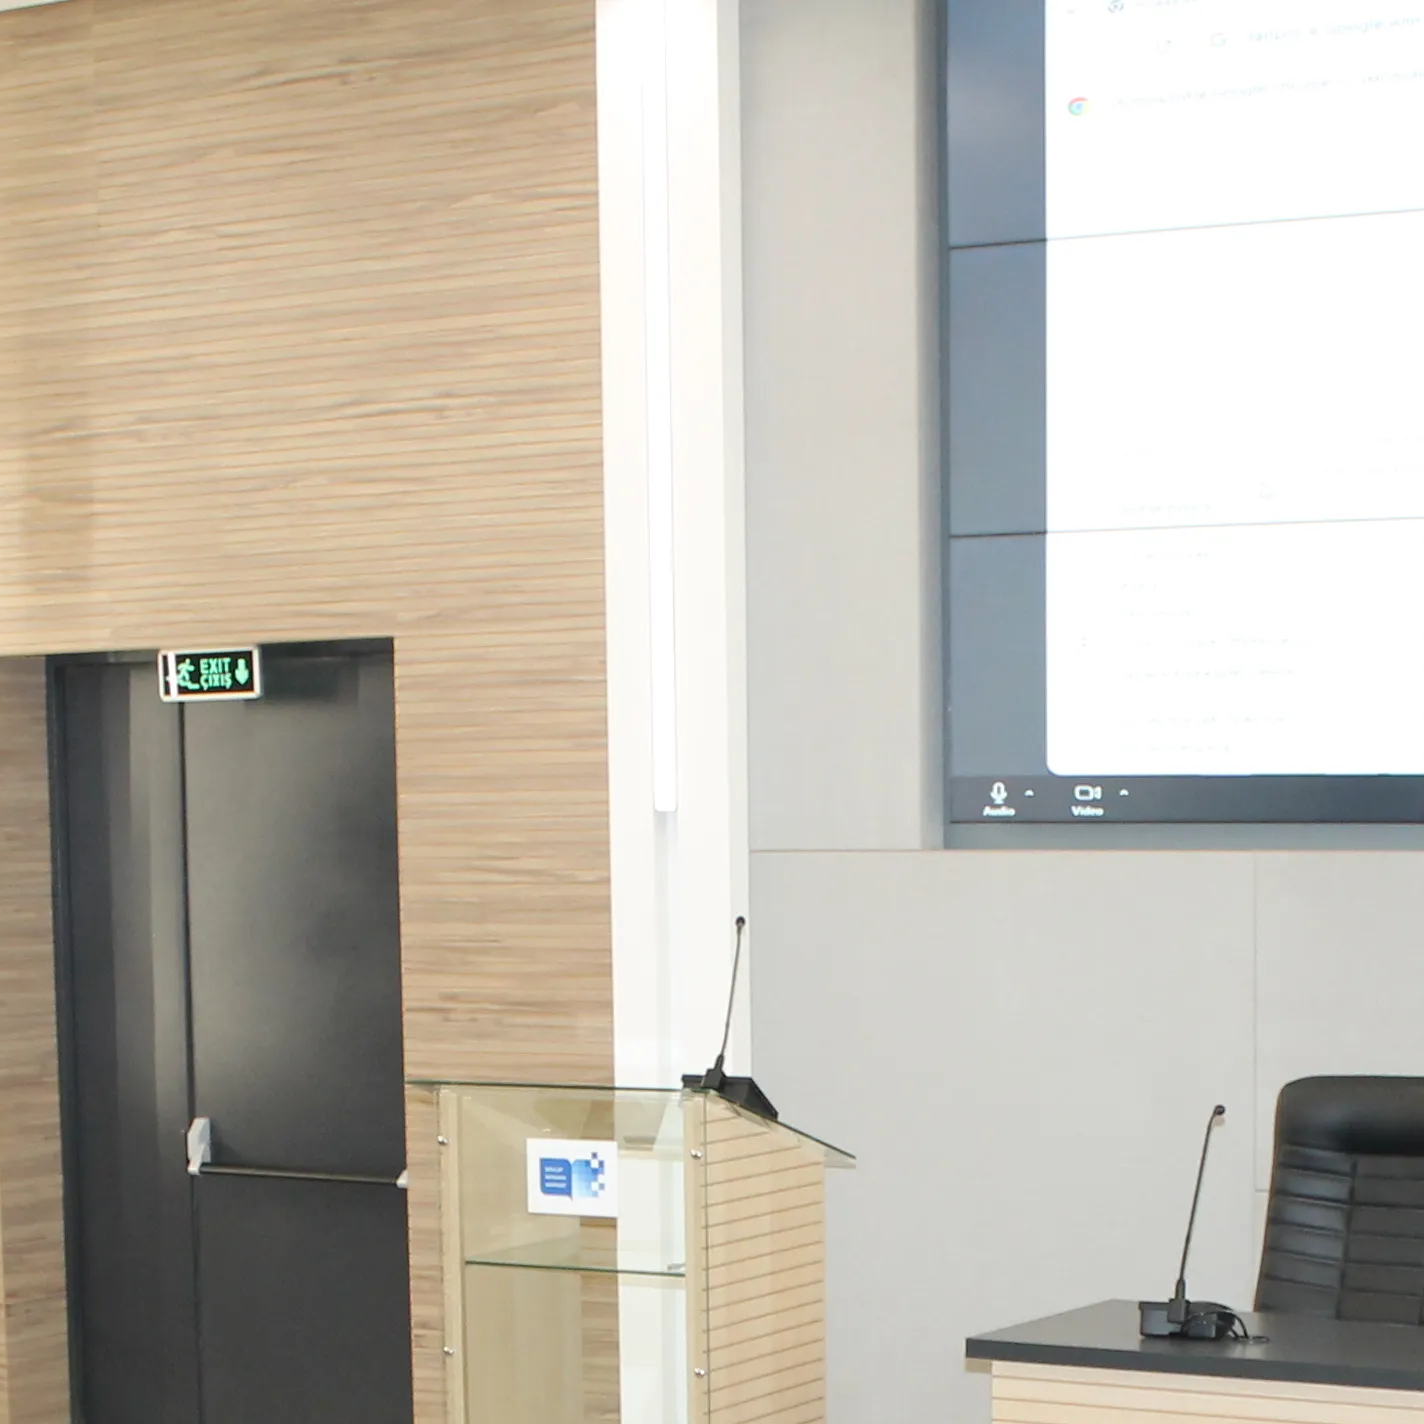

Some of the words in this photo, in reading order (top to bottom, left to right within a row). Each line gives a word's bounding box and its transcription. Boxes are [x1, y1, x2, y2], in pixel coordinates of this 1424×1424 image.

[199, 657, 232, 674] EXIT
[200, 673, 233, 691] ÇIXIŞ
[982, 805, 1016, 817] Audio
[1071, 805, 1105, 817] Video
